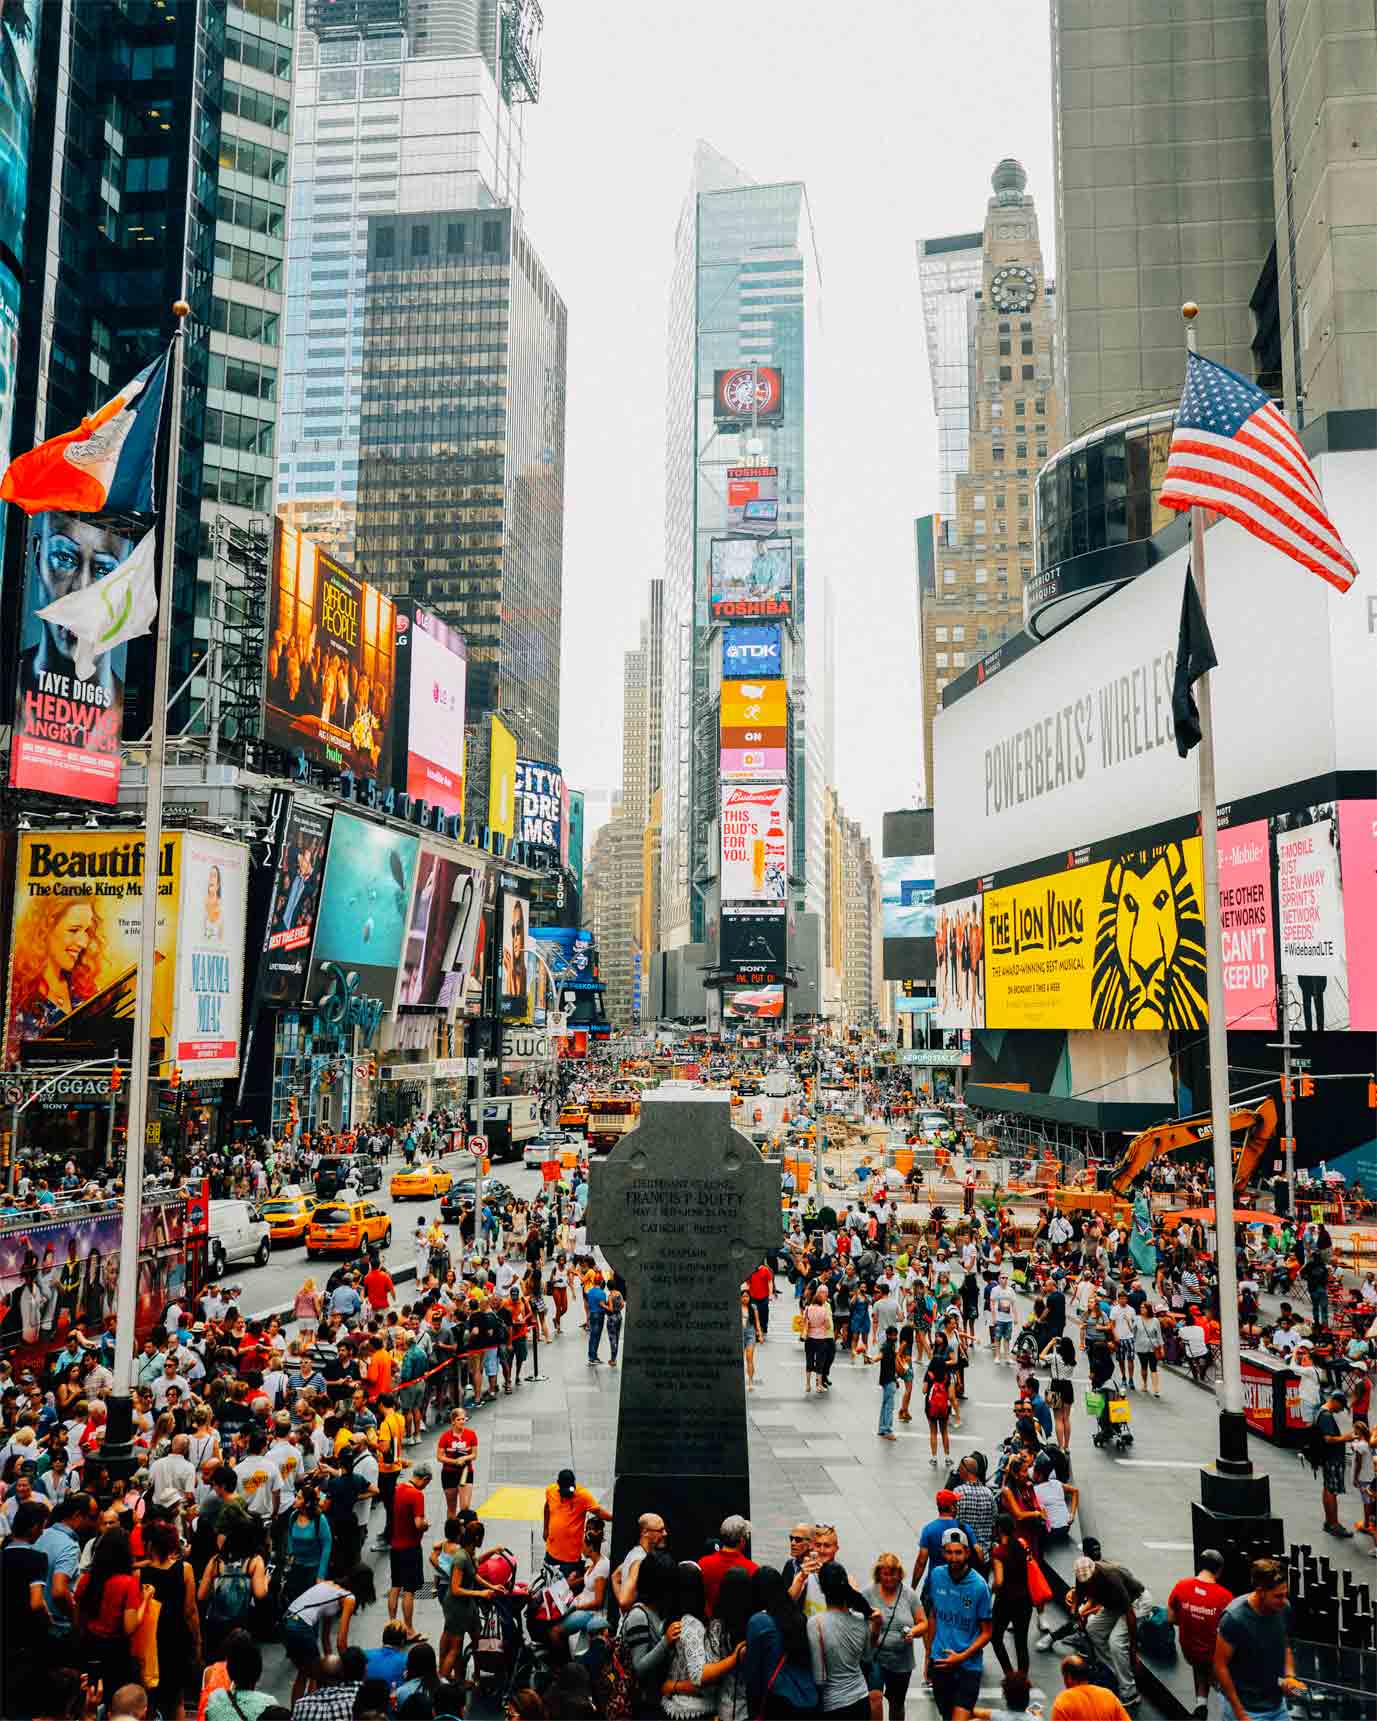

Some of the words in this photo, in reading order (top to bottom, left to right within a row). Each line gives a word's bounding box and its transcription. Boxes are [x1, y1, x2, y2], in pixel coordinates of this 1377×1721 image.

[727, 468, 776, 477] TOSHIBA
[323, 581, 358, 621] DIFFICULT
[713, 601, 790, 616] TOSHIBA
[322, 602, 357, 647] PEOPLE
[738, 644, 777, 657] TDK
[39, 670, 70, 697] TAYE
[73, 679, 112, 708] DIGGS
[25, 690, 119, 735] HEDWIG
[24, 719, 77, 745] ANGRY
[514, 763, 555, 797] CITY
[723, 810, 750, 822] THIS
[723, 823, 758, 836] BUD'S
[723, 837, 746, 848] FOR
[723, 850, 750, 862] YOU.
[1280, 859, 1297, 876] JUST
[28, 882, 51, 897] The
[52, 882, 93, 897] Carole
[95, 882, 124, 900] King
[1281, 873, 1302, 893] BLEW
[1303, 871, 1325, 889] AWAY
[1235, 884, 1264, 906] OTHER
[989, 912, 1010, 946] THE
[1012, 898, 1045, 955] LION
[1047, 889, 1084, 951] KING
[1282, 906, 1321, 925] NETWORK
[1221, 927, 1267, 962] CAN'T
[1284, 941, 1334, 956] #WidebandLTE
[1046, 959, 1058, 973] BEST
[1059, 957, 1085, 971] MUSICAL
[1252, 963, 1268, 989] UP
[1197, 1125, 1214, 1138] CAT
